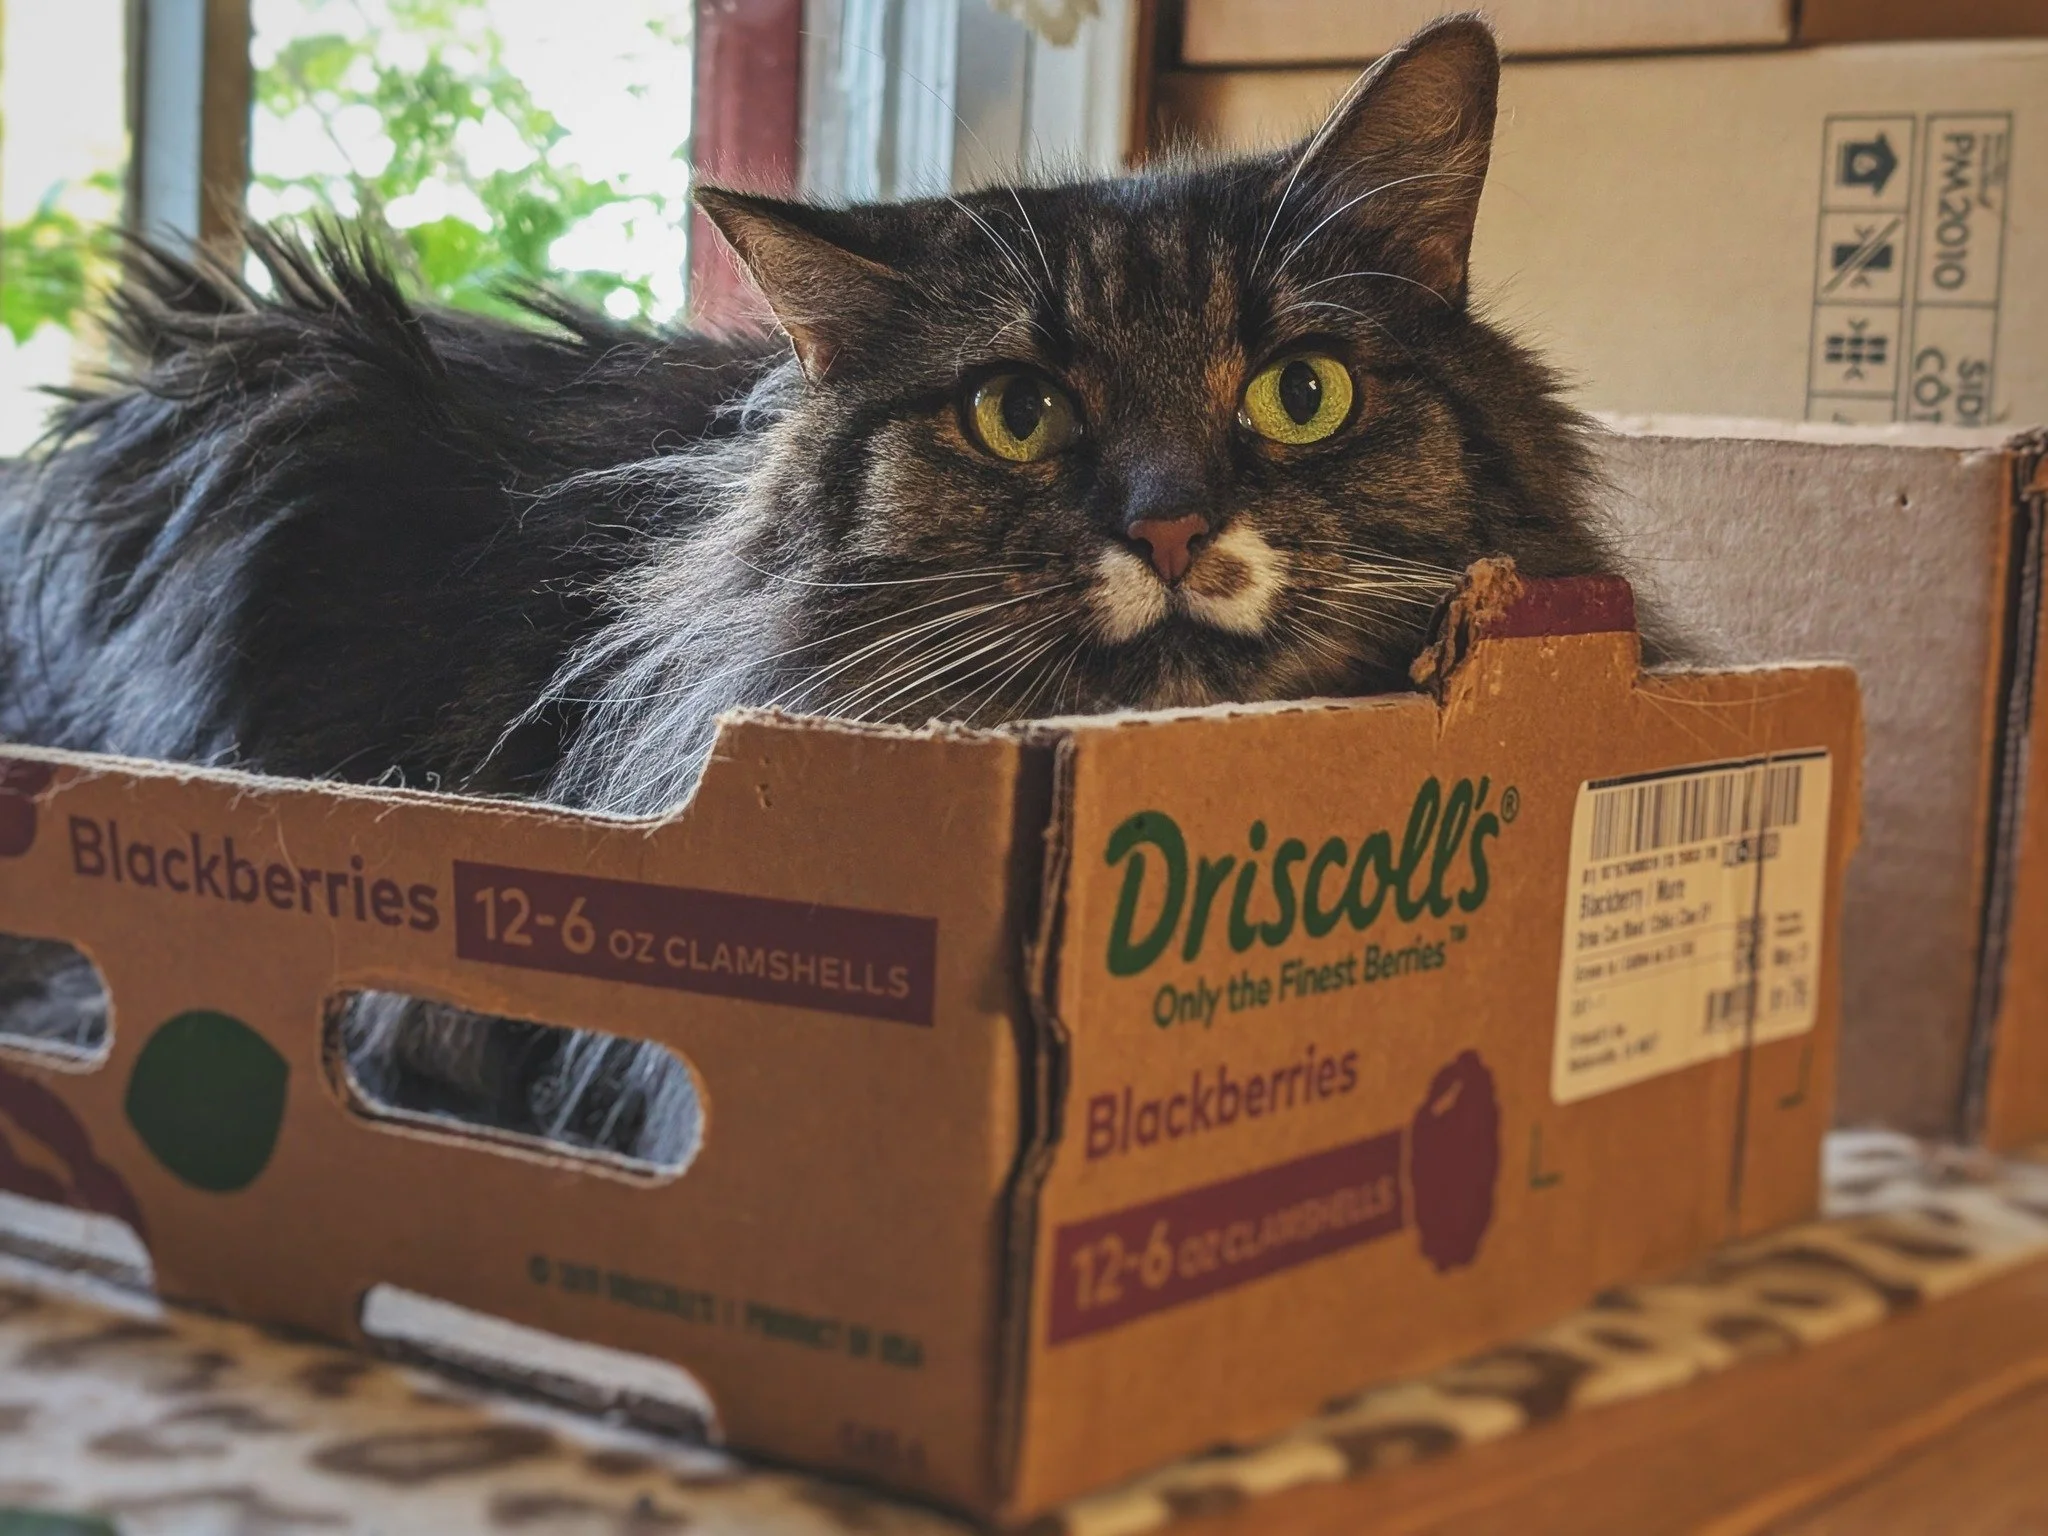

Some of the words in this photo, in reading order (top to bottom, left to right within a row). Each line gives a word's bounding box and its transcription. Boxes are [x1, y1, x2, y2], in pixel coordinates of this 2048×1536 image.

[69, 816, 441, 932] Blackberries
[474, 887, 596, 955] 12-6
[608, 929, 655, 963] OZ
[663, 936, 911, 999] CLAMSHELLS
[1153, 977, 1222, 1029] Only
[1228, 970, 1272, 1012] the
[1279, 951, 1356, 1000] Finest
[1086, 1044, 1359, 1161] Blackberries
[1072, 1221, 1173, 1311] 12-6
